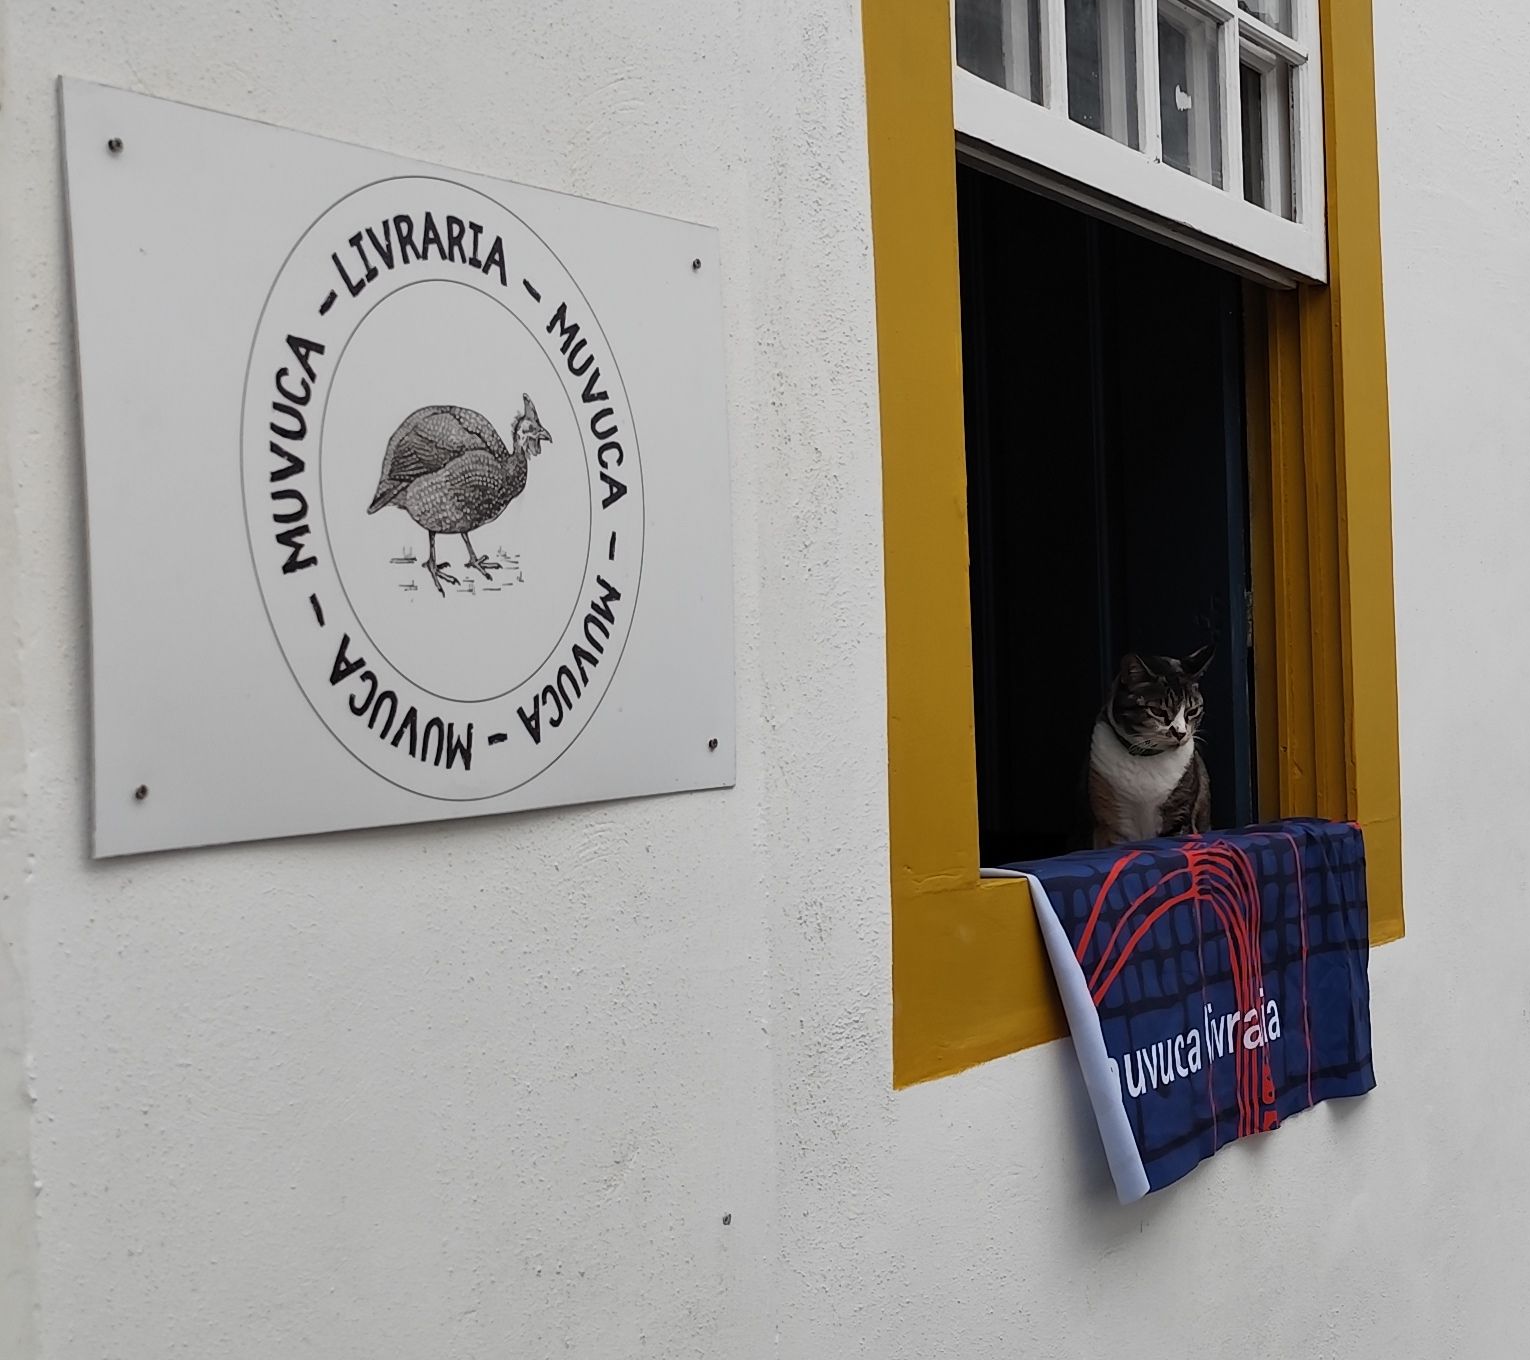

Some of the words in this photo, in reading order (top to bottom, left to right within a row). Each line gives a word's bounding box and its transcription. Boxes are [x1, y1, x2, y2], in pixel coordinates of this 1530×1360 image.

[331, 211, 507, 297] LIVRARIA
[270, 333, 326, 575] MUVUCA
[546, 302, 628, 510] MUVUCA
[329, 633, 473, 771] MUVUCA
[517, 574, 622, 745] MUVUCA
